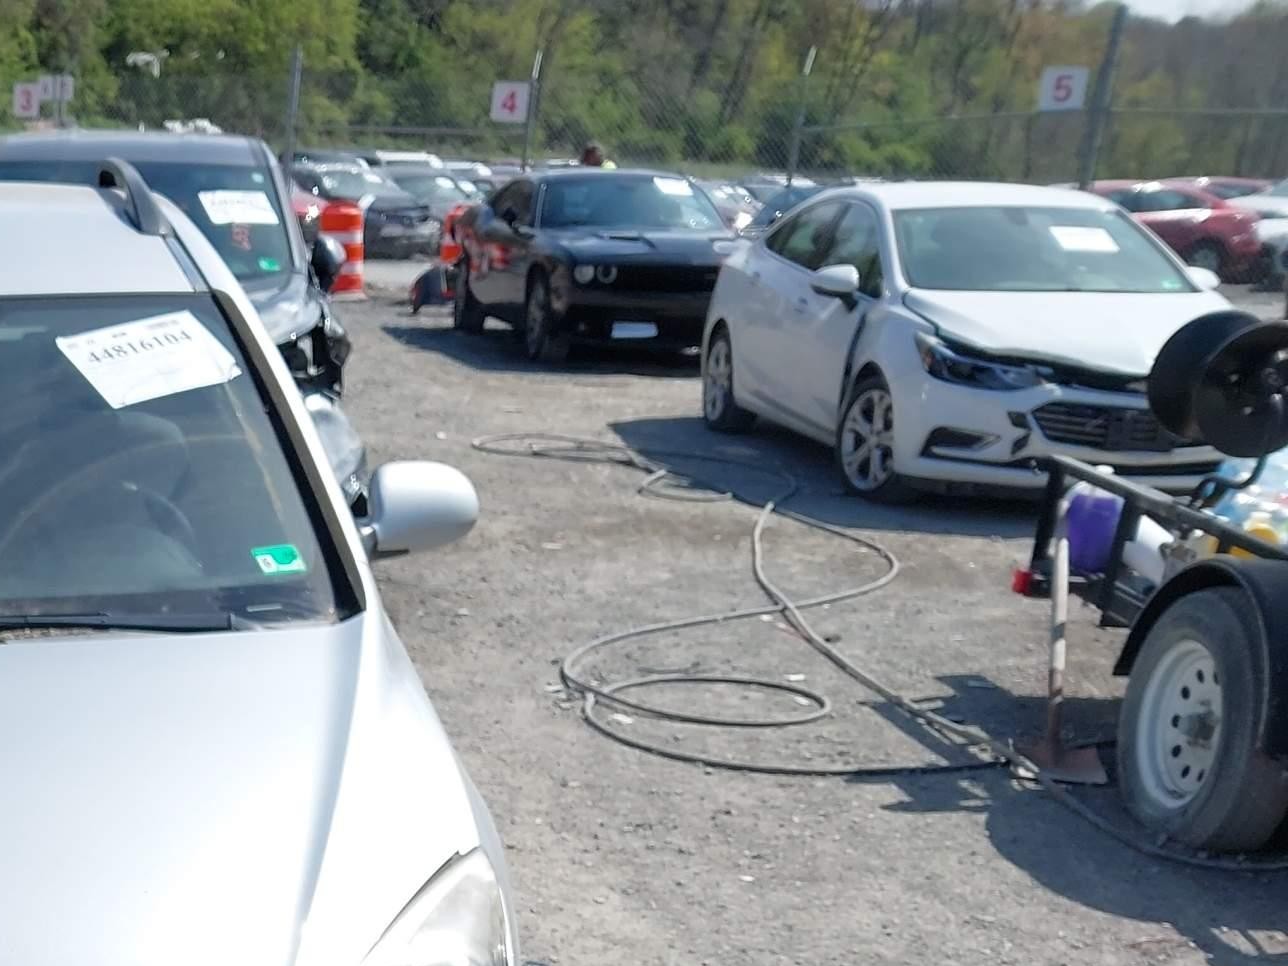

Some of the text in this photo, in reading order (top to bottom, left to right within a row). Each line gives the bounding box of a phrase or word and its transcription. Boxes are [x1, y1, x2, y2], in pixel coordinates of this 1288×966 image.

[19, 88, 33, 112] 3
[501, 89, 518, 113] 4
[1053, 74, 1074, 103] 5
[88, 329, 193, 363] 44816104
